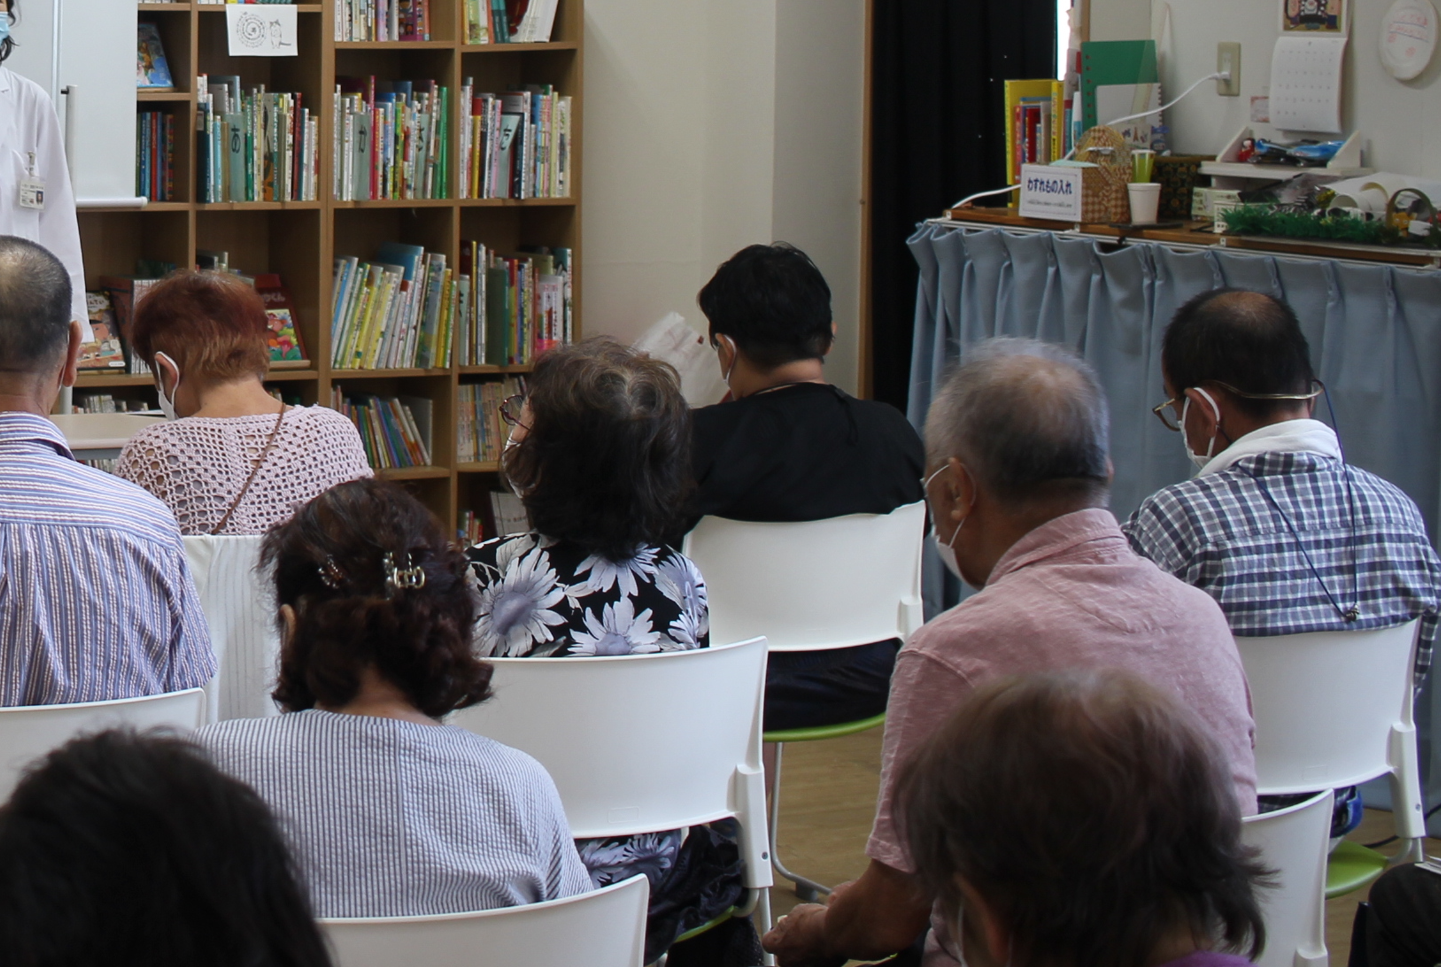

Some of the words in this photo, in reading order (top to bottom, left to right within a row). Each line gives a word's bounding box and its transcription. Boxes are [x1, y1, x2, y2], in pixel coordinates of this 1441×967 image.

[1027, 177, 1073, 195] わすれもの入れ
